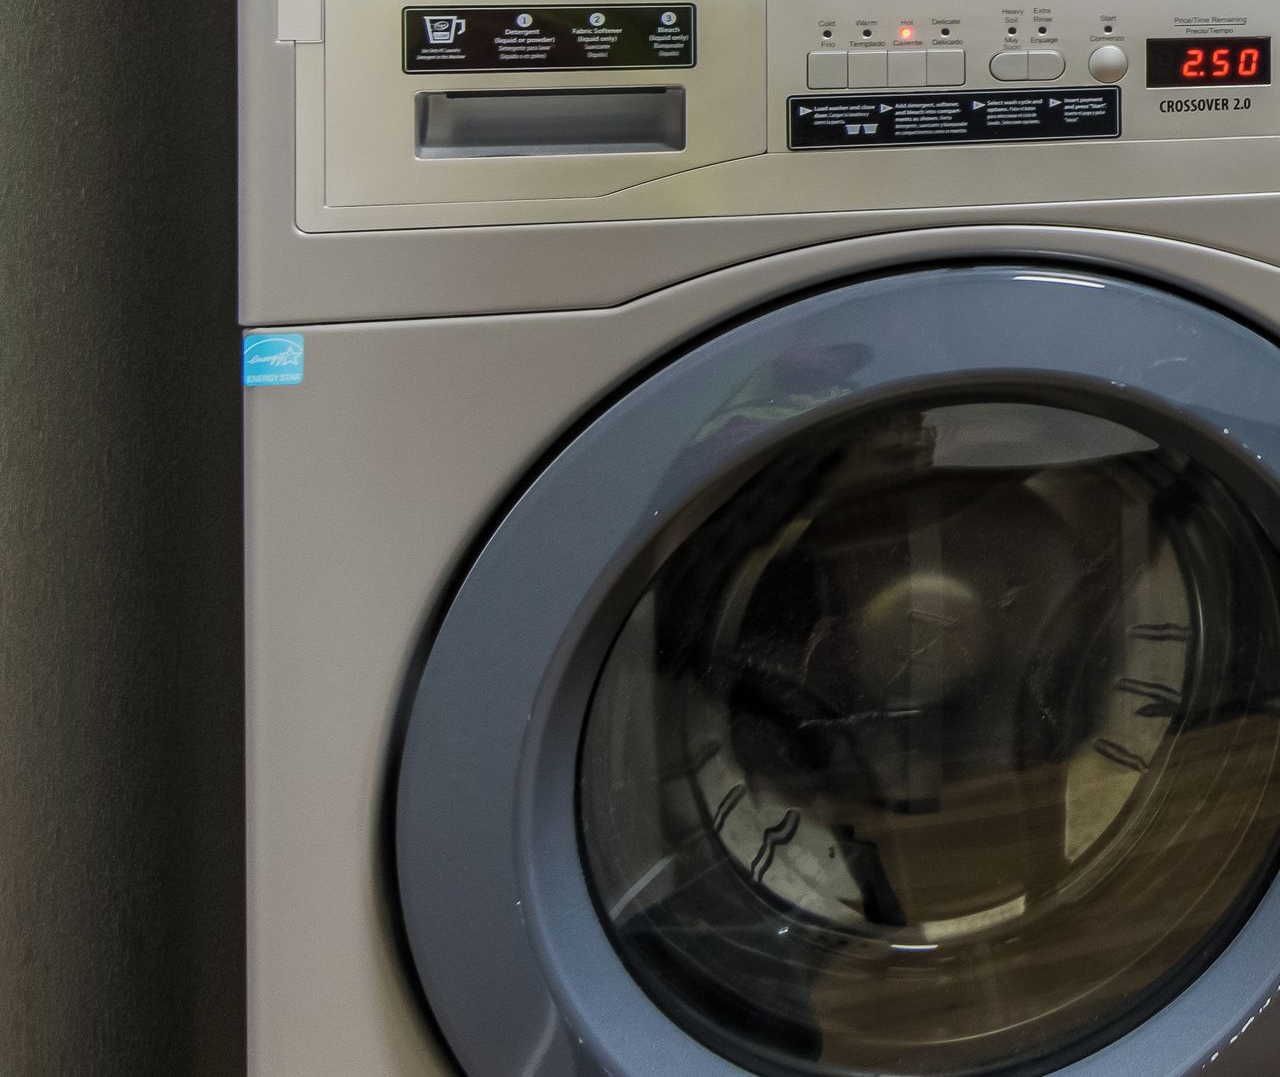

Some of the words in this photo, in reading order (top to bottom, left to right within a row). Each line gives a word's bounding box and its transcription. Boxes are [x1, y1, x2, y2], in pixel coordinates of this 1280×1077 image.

[1211, 16, 1247, 24] Remaining
[1185, 27, 1234, 35] Precio/Tiempo
[527, 36, 555, 44] powder)
[850, 40, 886, 48] Templado
[932, 38, 963, 46] Delicado
[1182, 48, 1260, 77] 2.50
[1159, 98, 1229, 113] CROSSOVER
[1233, 97, 1252, 110] 2.0
